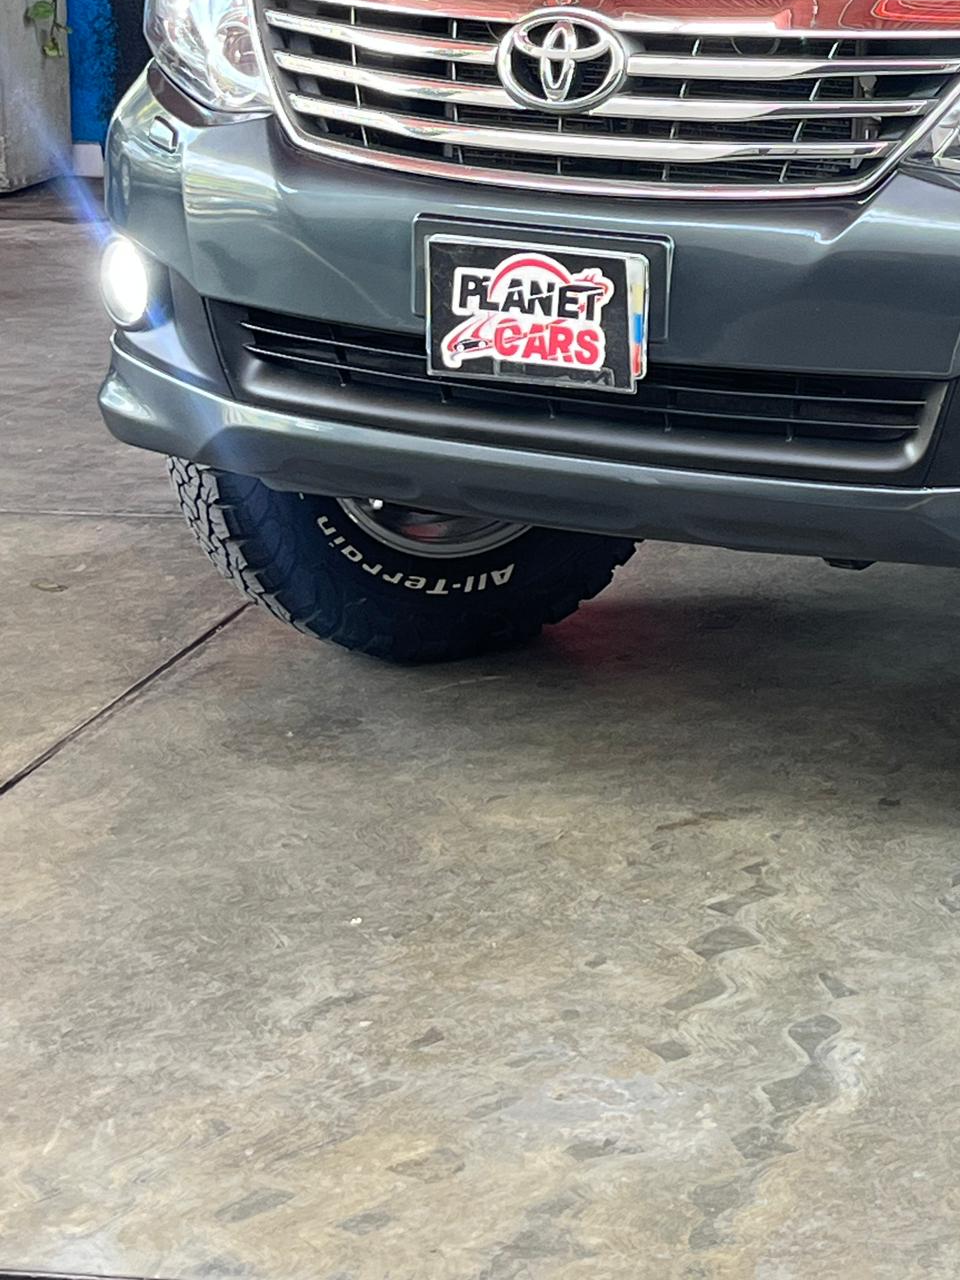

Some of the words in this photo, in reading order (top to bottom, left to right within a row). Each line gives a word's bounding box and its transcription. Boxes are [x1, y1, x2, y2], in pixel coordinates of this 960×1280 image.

[458, 273, 605, 321] PLANET
[493, 318, 600, 365] CARS
[316, 515, 516, 595] All-Terrain
